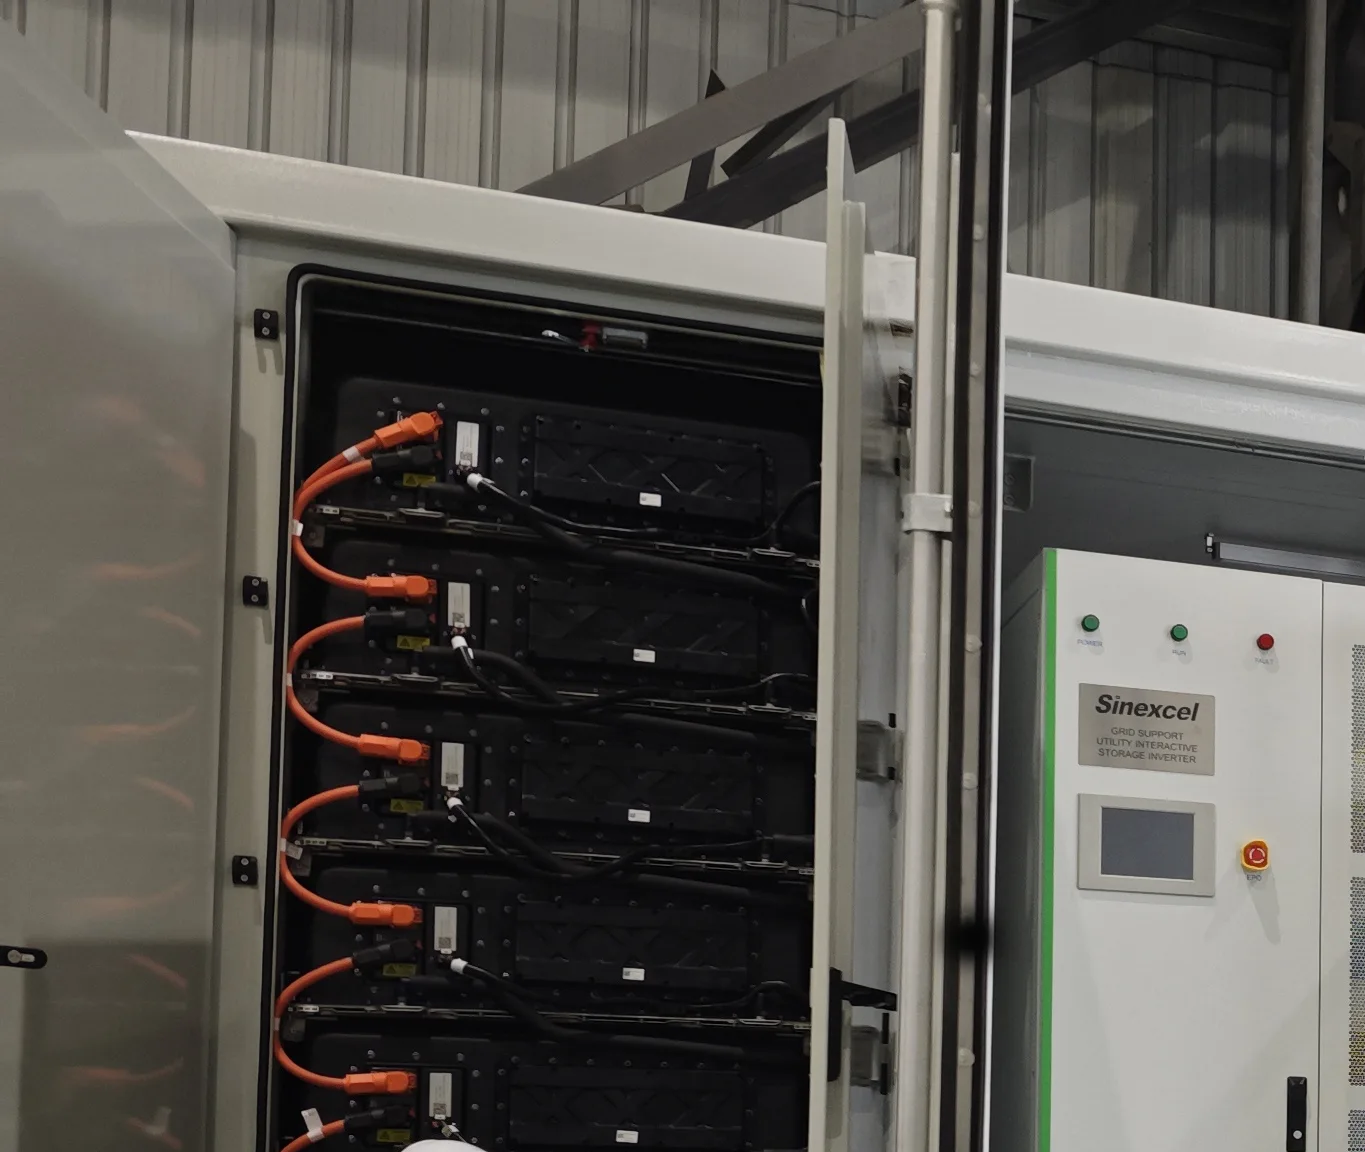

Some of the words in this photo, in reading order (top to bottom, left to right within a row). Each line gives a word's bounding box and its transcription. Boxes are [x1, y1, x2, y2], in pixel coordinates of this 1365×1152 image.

[1095, 693, 1200, 722] Sinexcel
[1110, 726, 1136, 738] GRID
[1137, 729, 1184, 741] SUPPORT
[1096, 737, 1133, 747] UTILITY
[1135, 740, 1199, 753] INTERACTIVE
[1097, 747, 1146, 760] STORAGE
[1148, 752, 1197, 764] INVERTER
